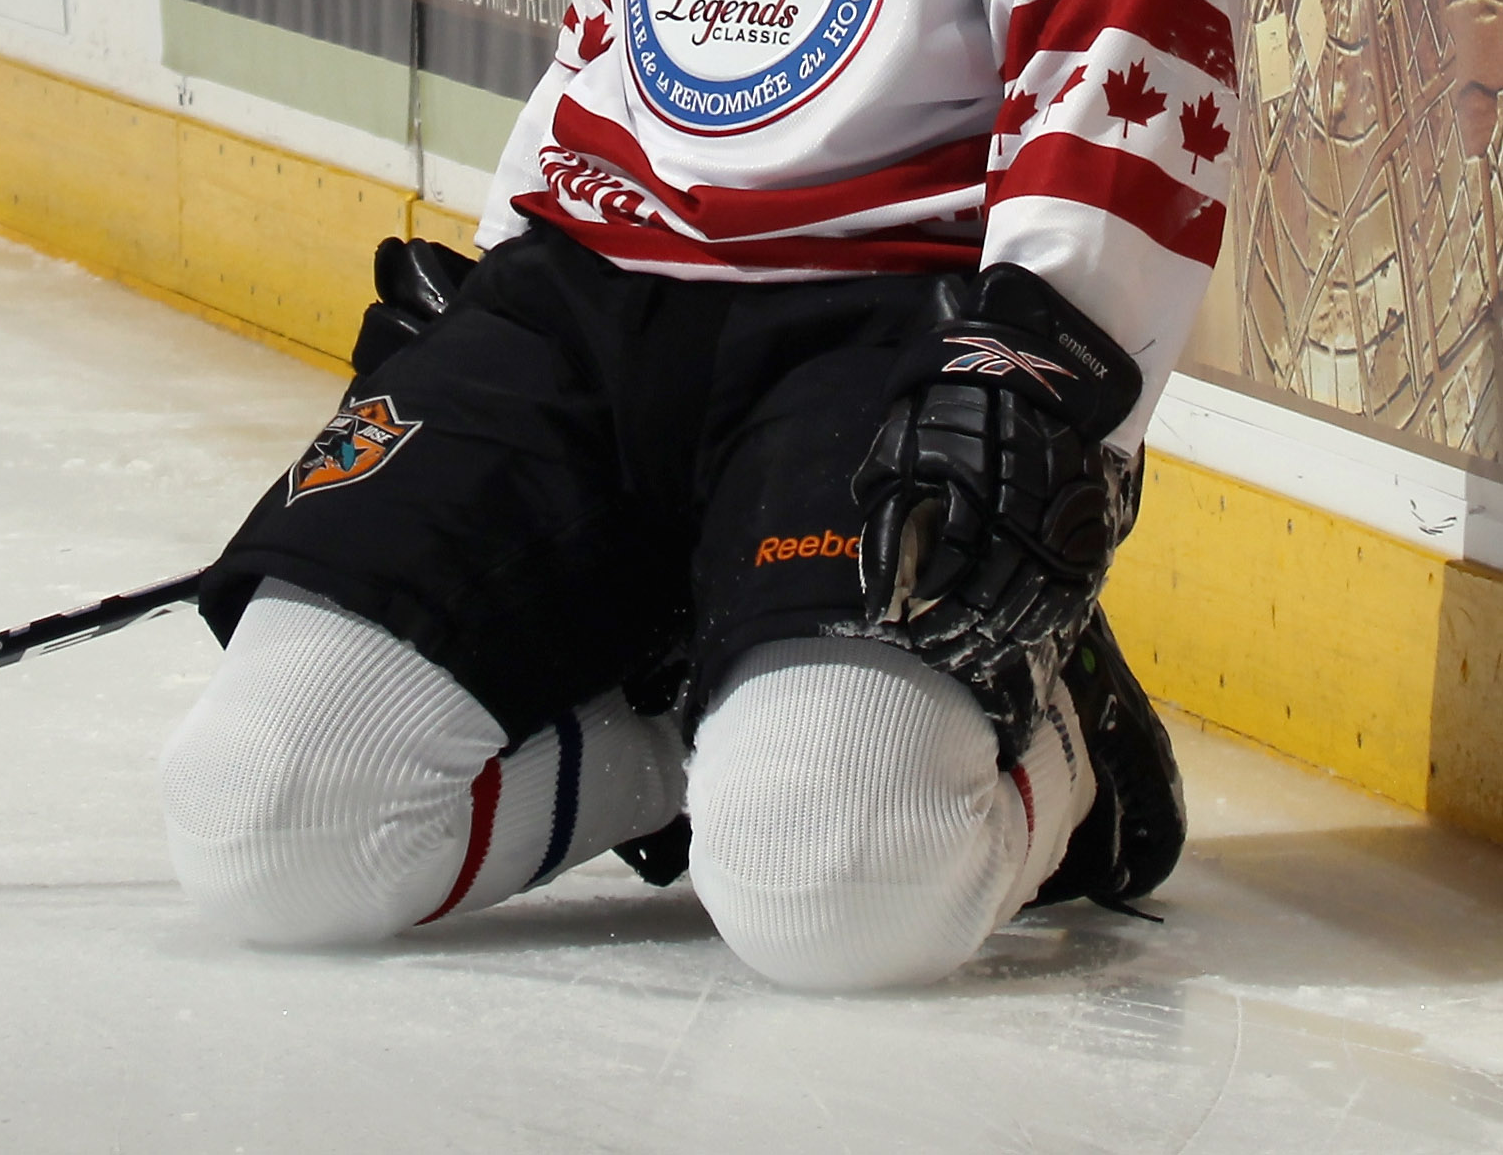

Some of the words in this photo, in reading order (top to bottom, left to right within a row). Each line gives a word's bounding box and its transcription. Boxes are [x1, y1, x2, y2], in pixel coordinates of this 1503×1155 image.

[711, 28, 792, 45] CLASSIC
[640, 42, 657, 77] de
[655, 73, 670, 95] LA
[668, 71, 793, 116] RENOMMÉE
[799, 46, 827, 80] du
[1056, 322, 1108, 380] emieux
[755, 528, 860, 567] Reebo
